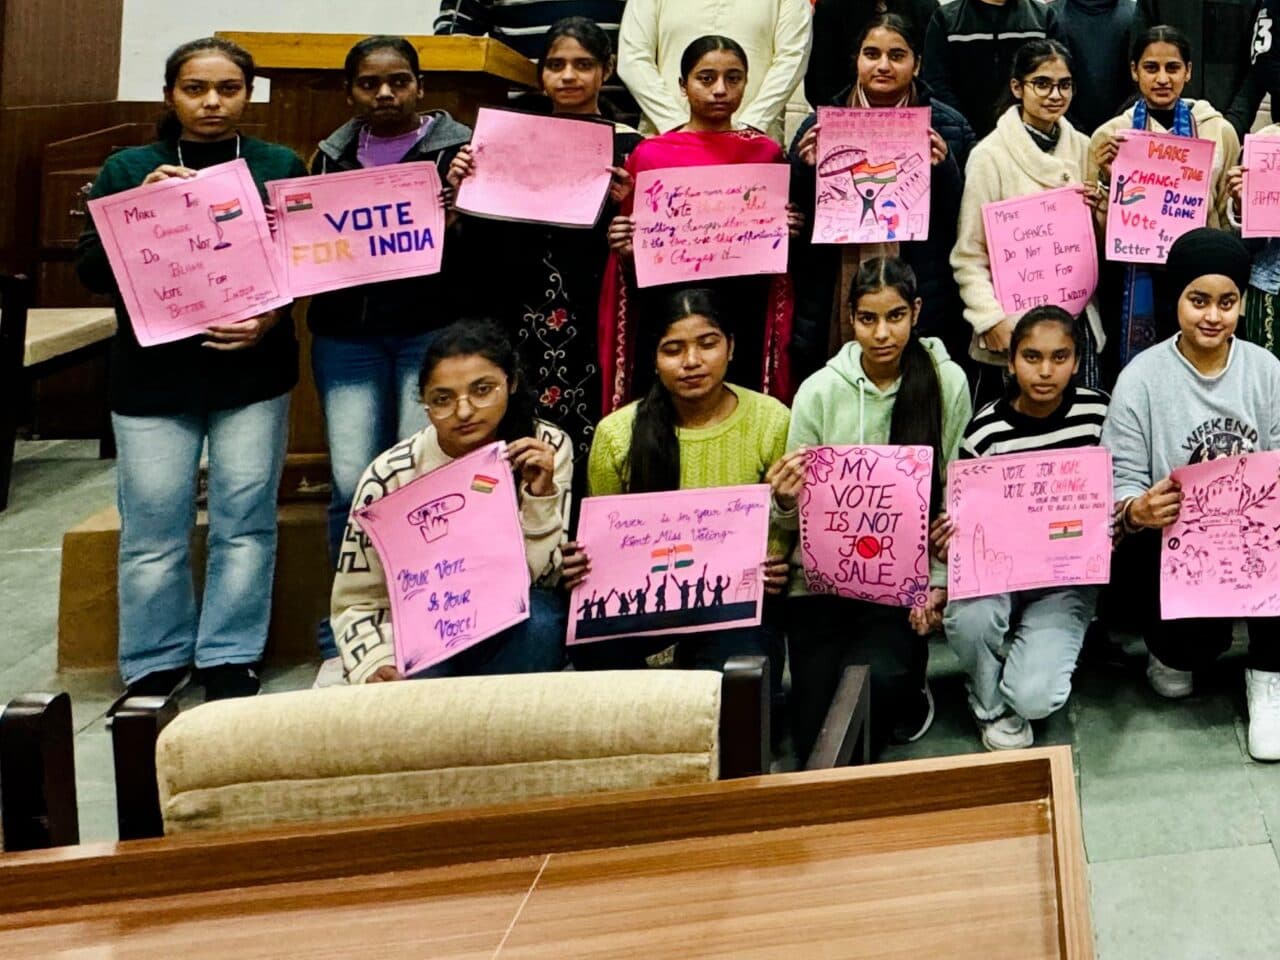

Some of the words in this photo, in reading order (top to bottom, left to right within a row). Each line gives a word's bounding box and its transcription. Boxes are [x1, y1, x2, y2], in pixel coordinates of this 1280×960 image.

[1147, 140, 1191, 163] MAKE
[1129, 170, 1180, 189] CHANGE
[1161, 204, 1196, 220] BLAME
[1182, 195, 1204, 207] NOT
[323, 202, 413, 233] VOTE
[291, 241, 355, 267] FOR
[368, 228, 435, 257] INDIA
[1181, 417, 1258, 451] WEEKEND
[840, 457, 879, 481] MY
[831, 484, 896, 509] VOTE
[824, 511, 849, 532] IS
[856, 512, 903, 533] NOT
[834, 559, 896, 587] SALE
